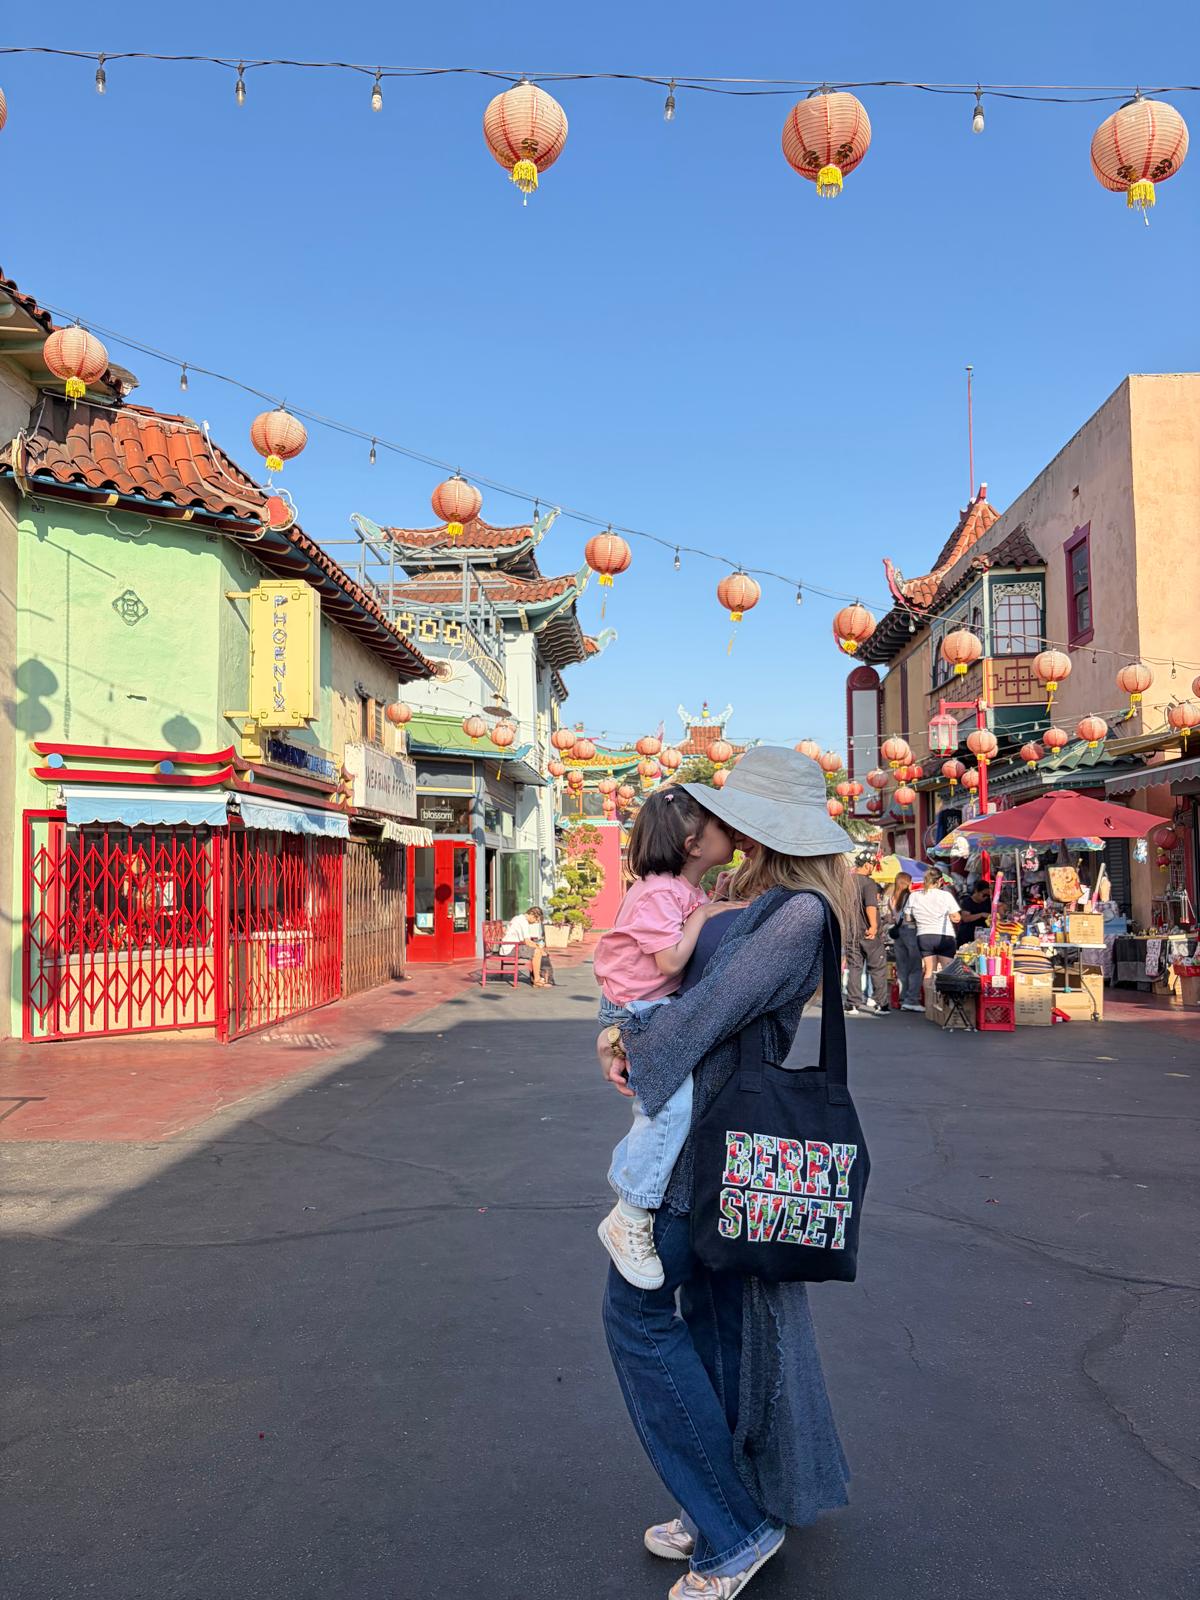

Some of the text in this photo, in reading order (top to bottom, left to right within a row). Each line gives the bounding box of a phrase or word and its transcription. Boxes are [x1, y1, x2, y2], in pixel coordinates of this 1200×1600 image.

[423, 810, 452, 820] blossom
[722, 1130, 858, 1198] BERRY
[718, 1187, 853, 1250] SWEET
